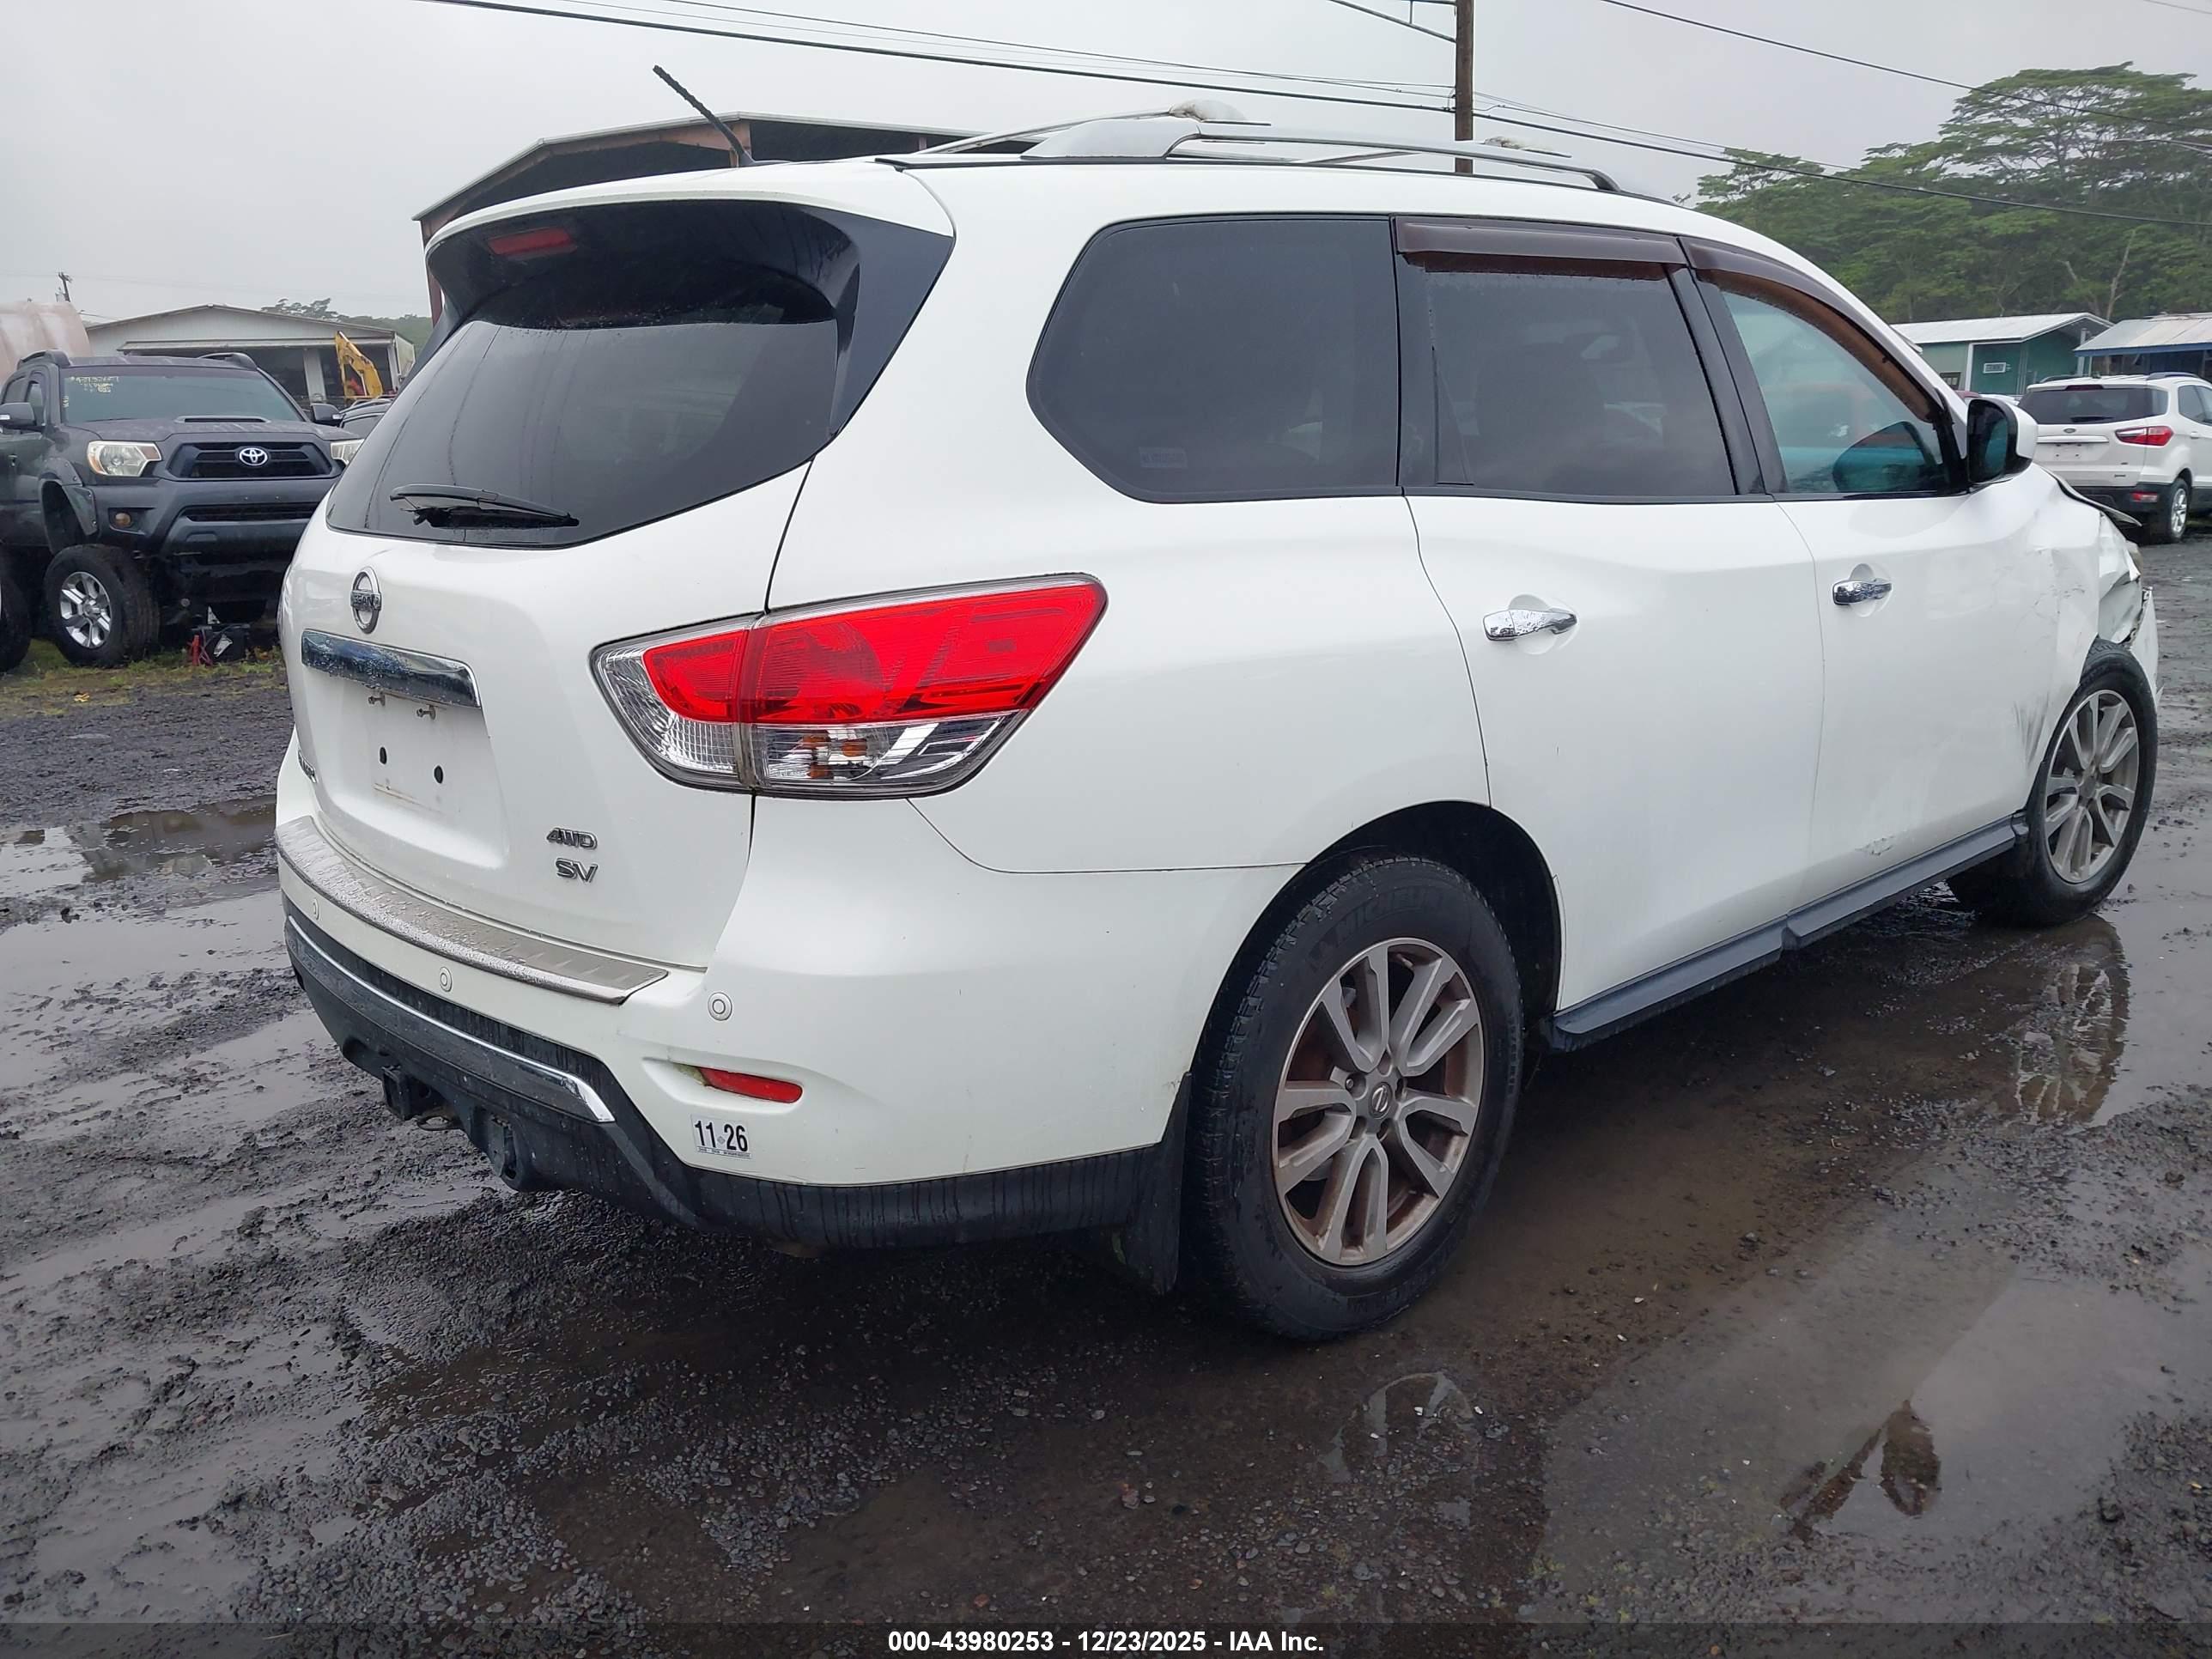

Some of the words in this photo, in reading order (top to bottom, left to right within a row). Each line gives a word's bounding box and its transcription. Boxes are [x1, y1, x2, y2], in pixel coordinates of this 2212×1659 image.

[547, 828, 598, 849] 4WD
[556, 858, 599, 883] SV
[695, 1121, 716, 1148] 11
[724, 1124, 748, 1152] 26
